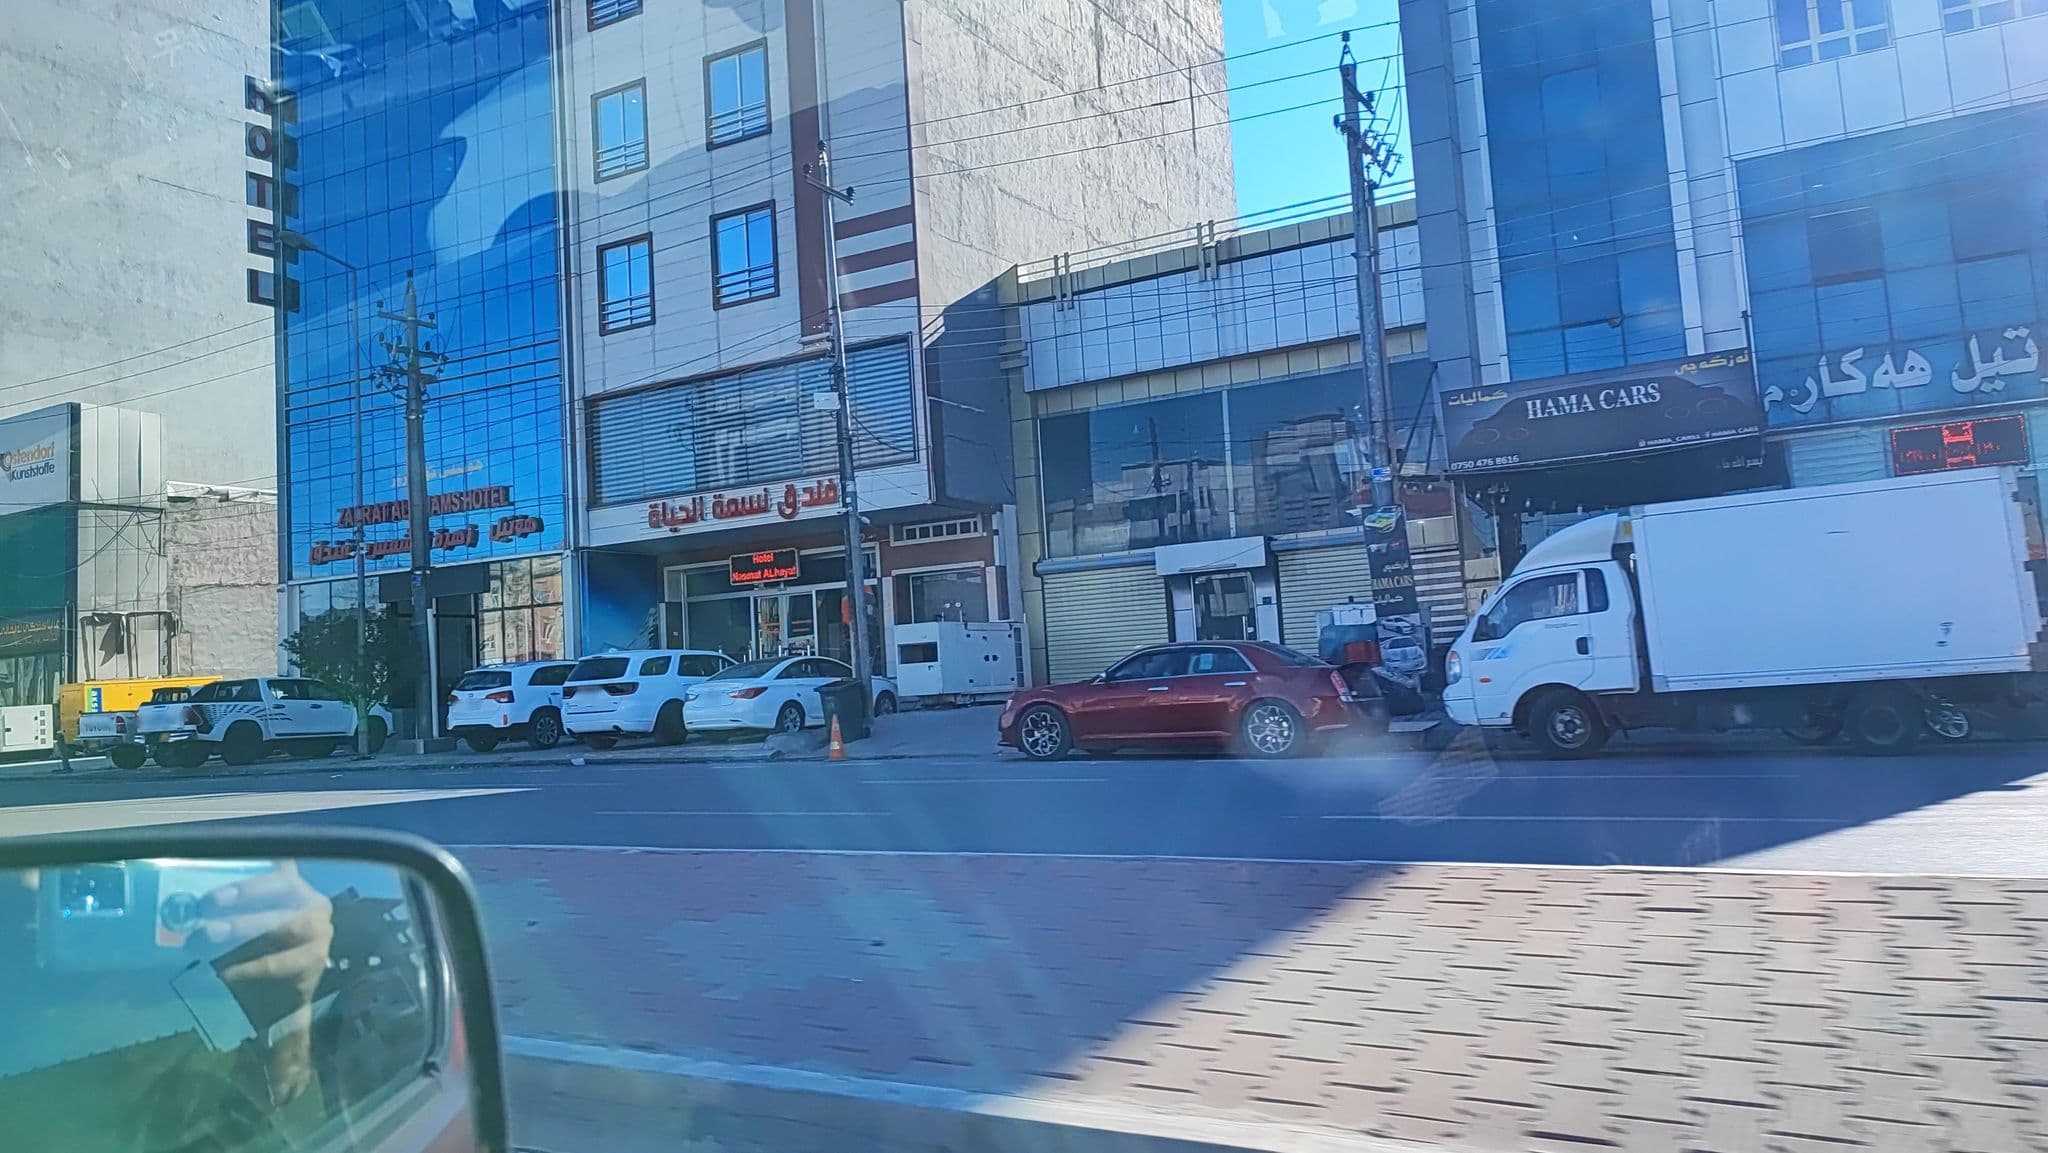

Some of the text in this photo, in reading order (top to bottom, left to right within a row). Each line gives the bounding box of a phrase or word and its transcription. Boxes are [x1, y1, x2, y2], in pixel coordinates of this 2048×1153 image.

[1525, 382, 1661, 420] HAMA CARS
[1450, 460, 1475, 471] 0750
[462, 486, 509, 510] HOTEL
[647, 479, 840, 533] فندق نسمة الحياة
[752, 552, 774, 564] Hotel
